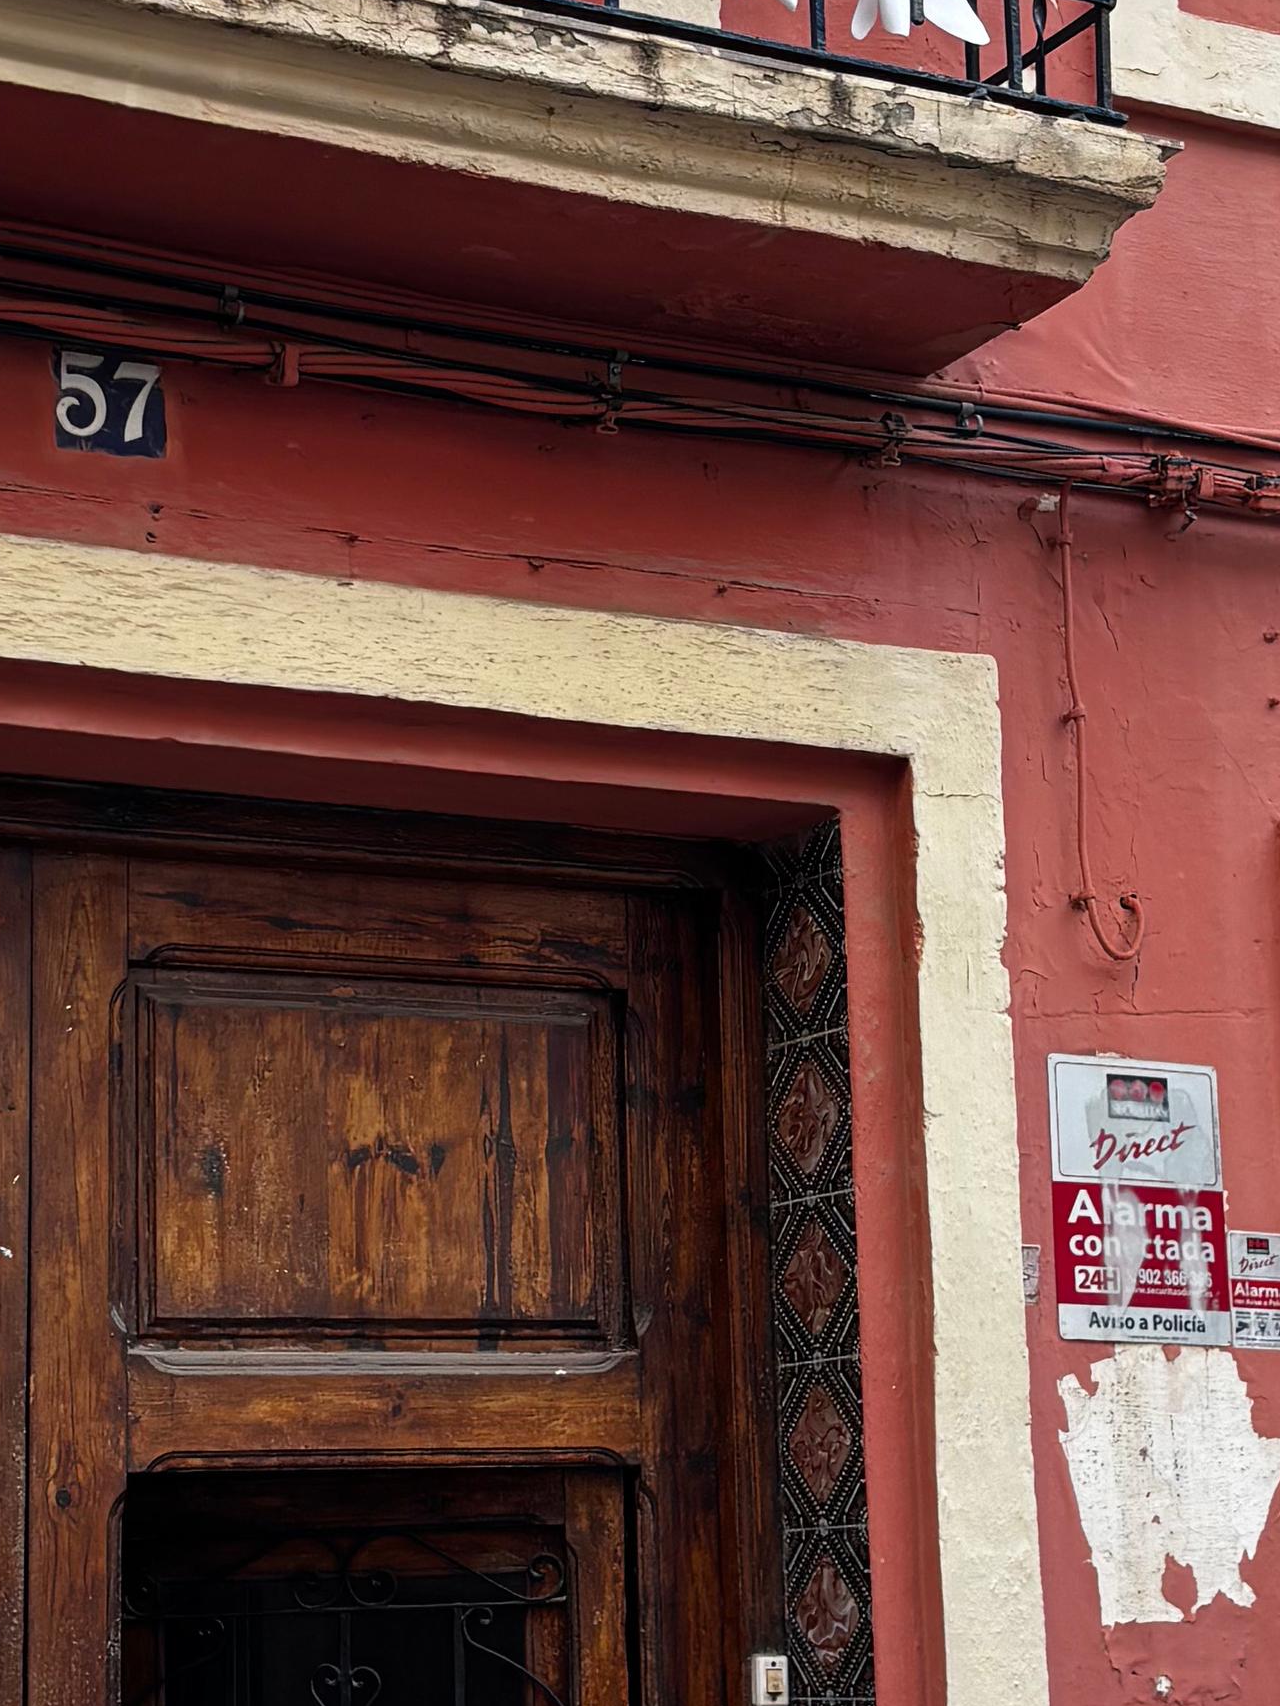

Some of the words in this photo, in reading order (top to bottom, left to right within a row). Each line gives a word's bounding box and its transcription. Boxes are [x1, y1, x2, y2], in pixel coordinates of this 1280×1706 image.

[56, 351, 161, 443] 57
[1090, 1122, 1197, 1170] Direct
[1067, 1185, 1213, 1232] Alarma
[1069, 1233, 1215, 1263] conctada
[1238, 1254, 1279, 1273] Direct
[1077, 1268, 1118, 1291] 24H
[1138, 1268, 1162, 1285] 902
[1164, 1269, 1187, 1286] 366
[1088, 1311, 1135, 1330] Aviso
[1139, 1316, 1149, 1330] a
[1153, 1313, 1206, 1333] Policía
